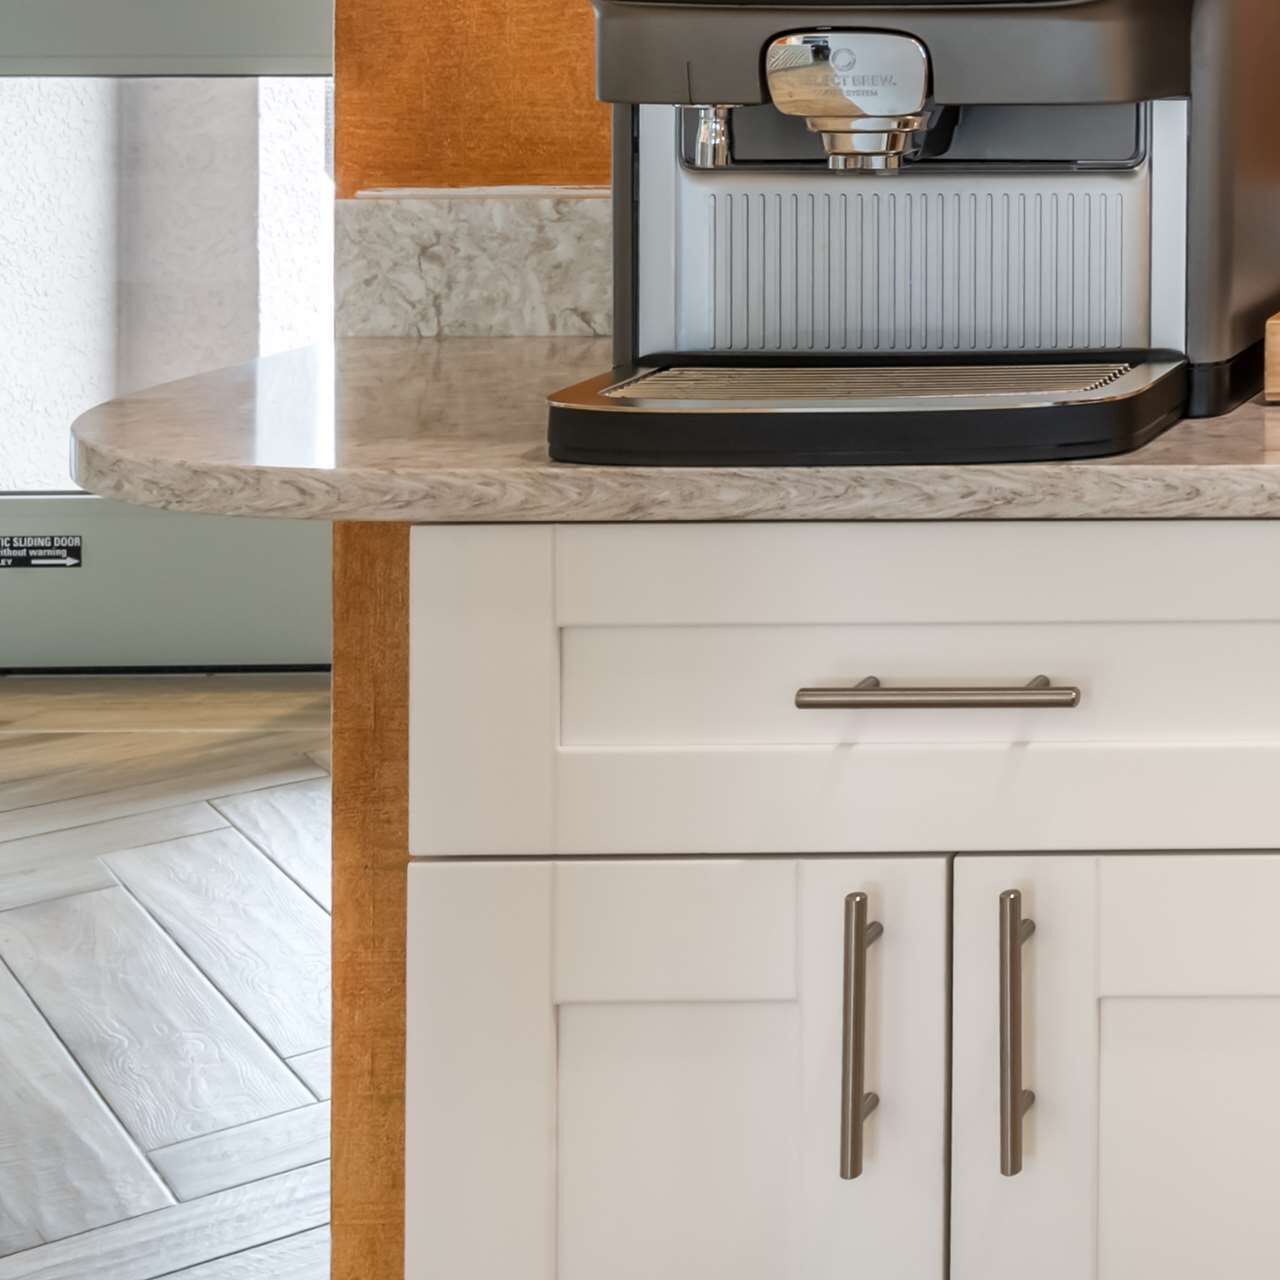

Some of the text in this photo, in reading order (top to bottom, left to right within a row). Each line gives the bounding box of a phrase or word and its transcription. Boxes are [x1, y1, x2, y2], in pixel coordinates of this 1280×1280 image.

[12, 536, 52, 547] SLIDING
[53, 536, 81, 547] DOOR
[28, 548, 67, 558] warning
